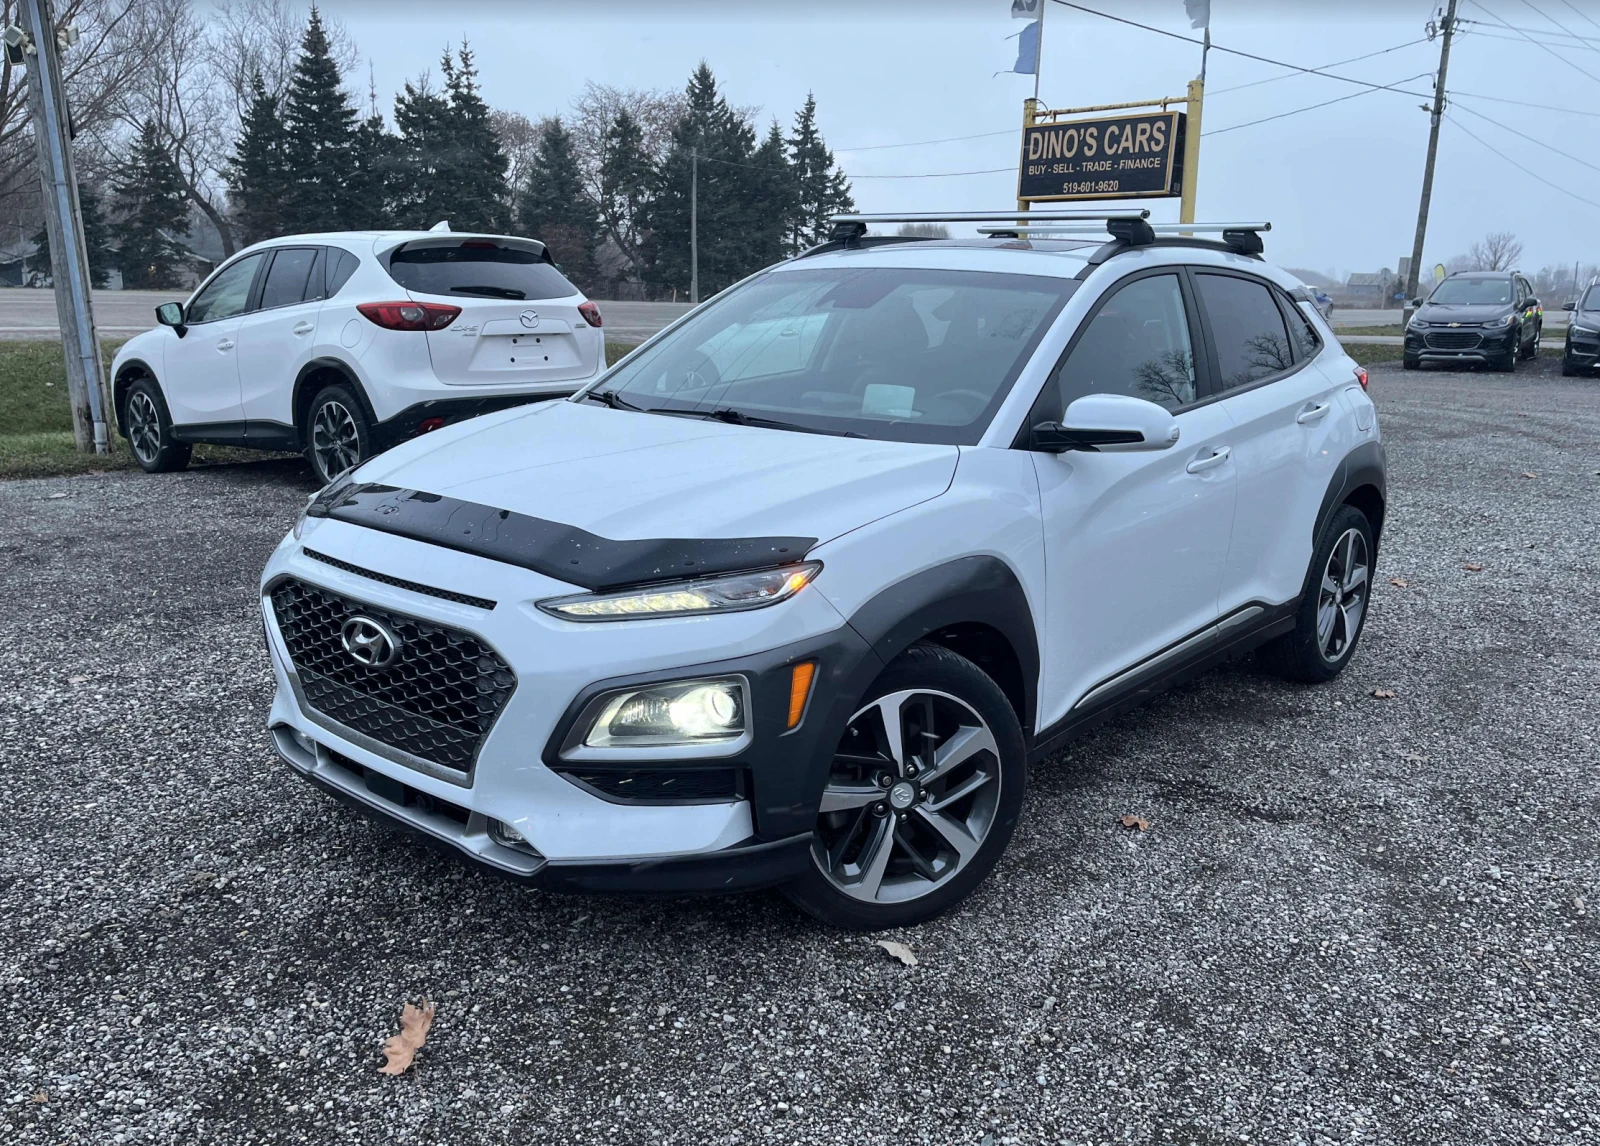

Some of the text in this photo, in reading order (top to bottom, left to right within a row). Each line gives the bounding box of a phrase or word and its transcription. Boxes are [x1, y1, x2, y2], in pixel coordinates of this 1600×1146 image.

[1028, 121, 1166, 160] DINO'S CARS
[1028, 164, 1048, 175] BUY
[1052, 163, 1074, 173] SELL
[1082, 160, 1112, 172] TRADE
[1120, 158, 1160, 170] FINANCE
[1063, 180, 1118, 193] 519-601-9620
